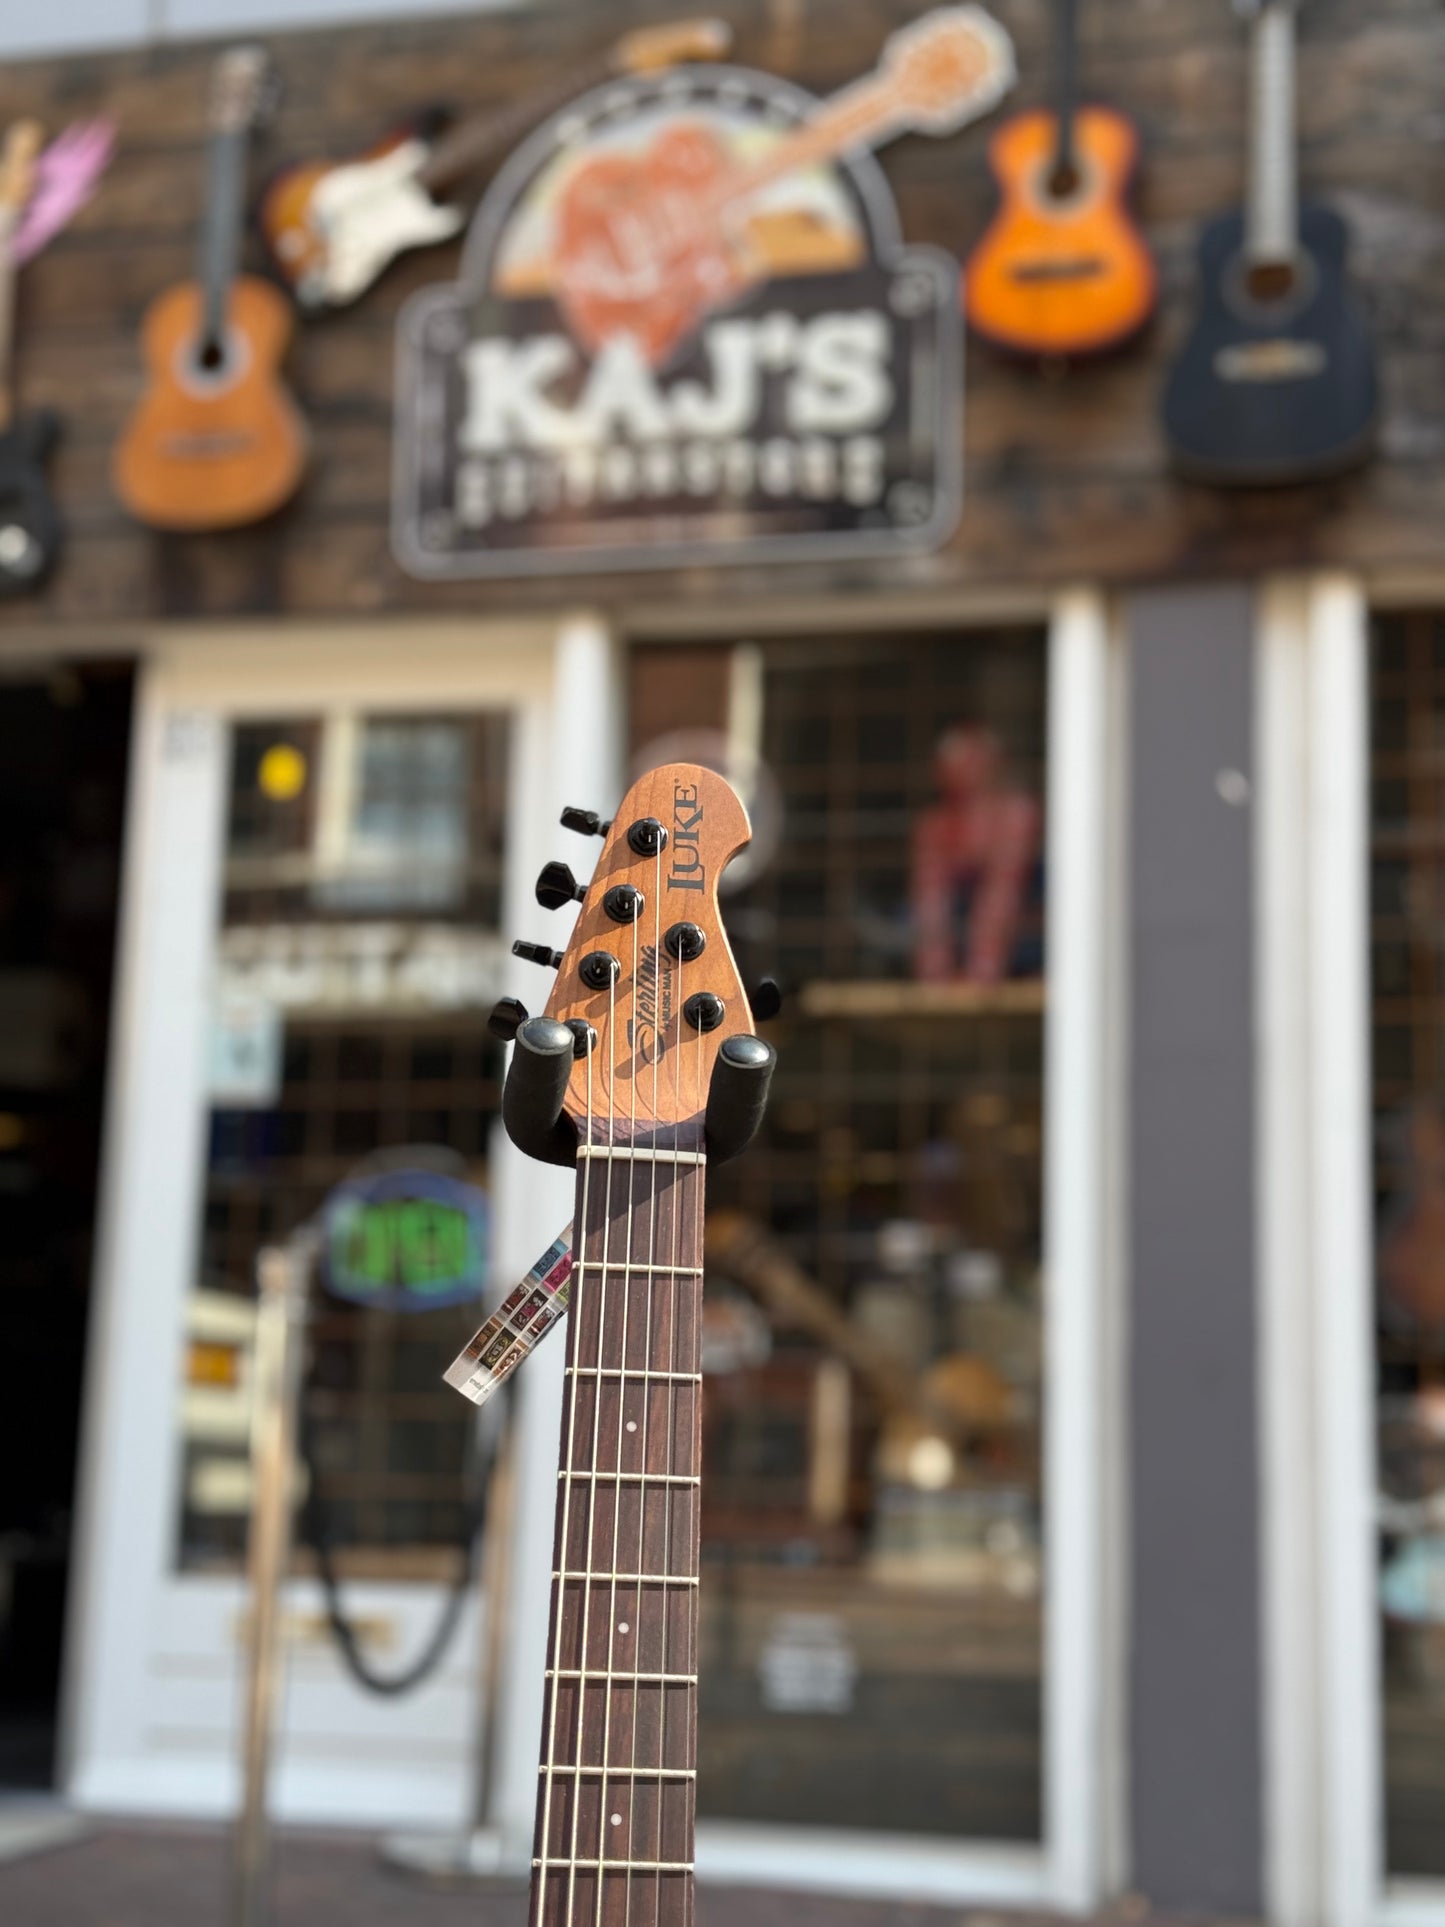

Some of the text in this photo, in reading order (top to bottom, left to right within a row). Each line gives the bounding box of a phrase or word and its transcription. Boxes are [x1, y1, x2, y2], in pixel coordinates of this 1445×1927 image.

[461, 313, 892, 453] KAJ'S
[667, 783, 704, 895] LUKE
[627, 945, 670, 1065] Sterling
[661, 991, 671, 1021] MUSIC
[662, 968, 671, 990] MAN
